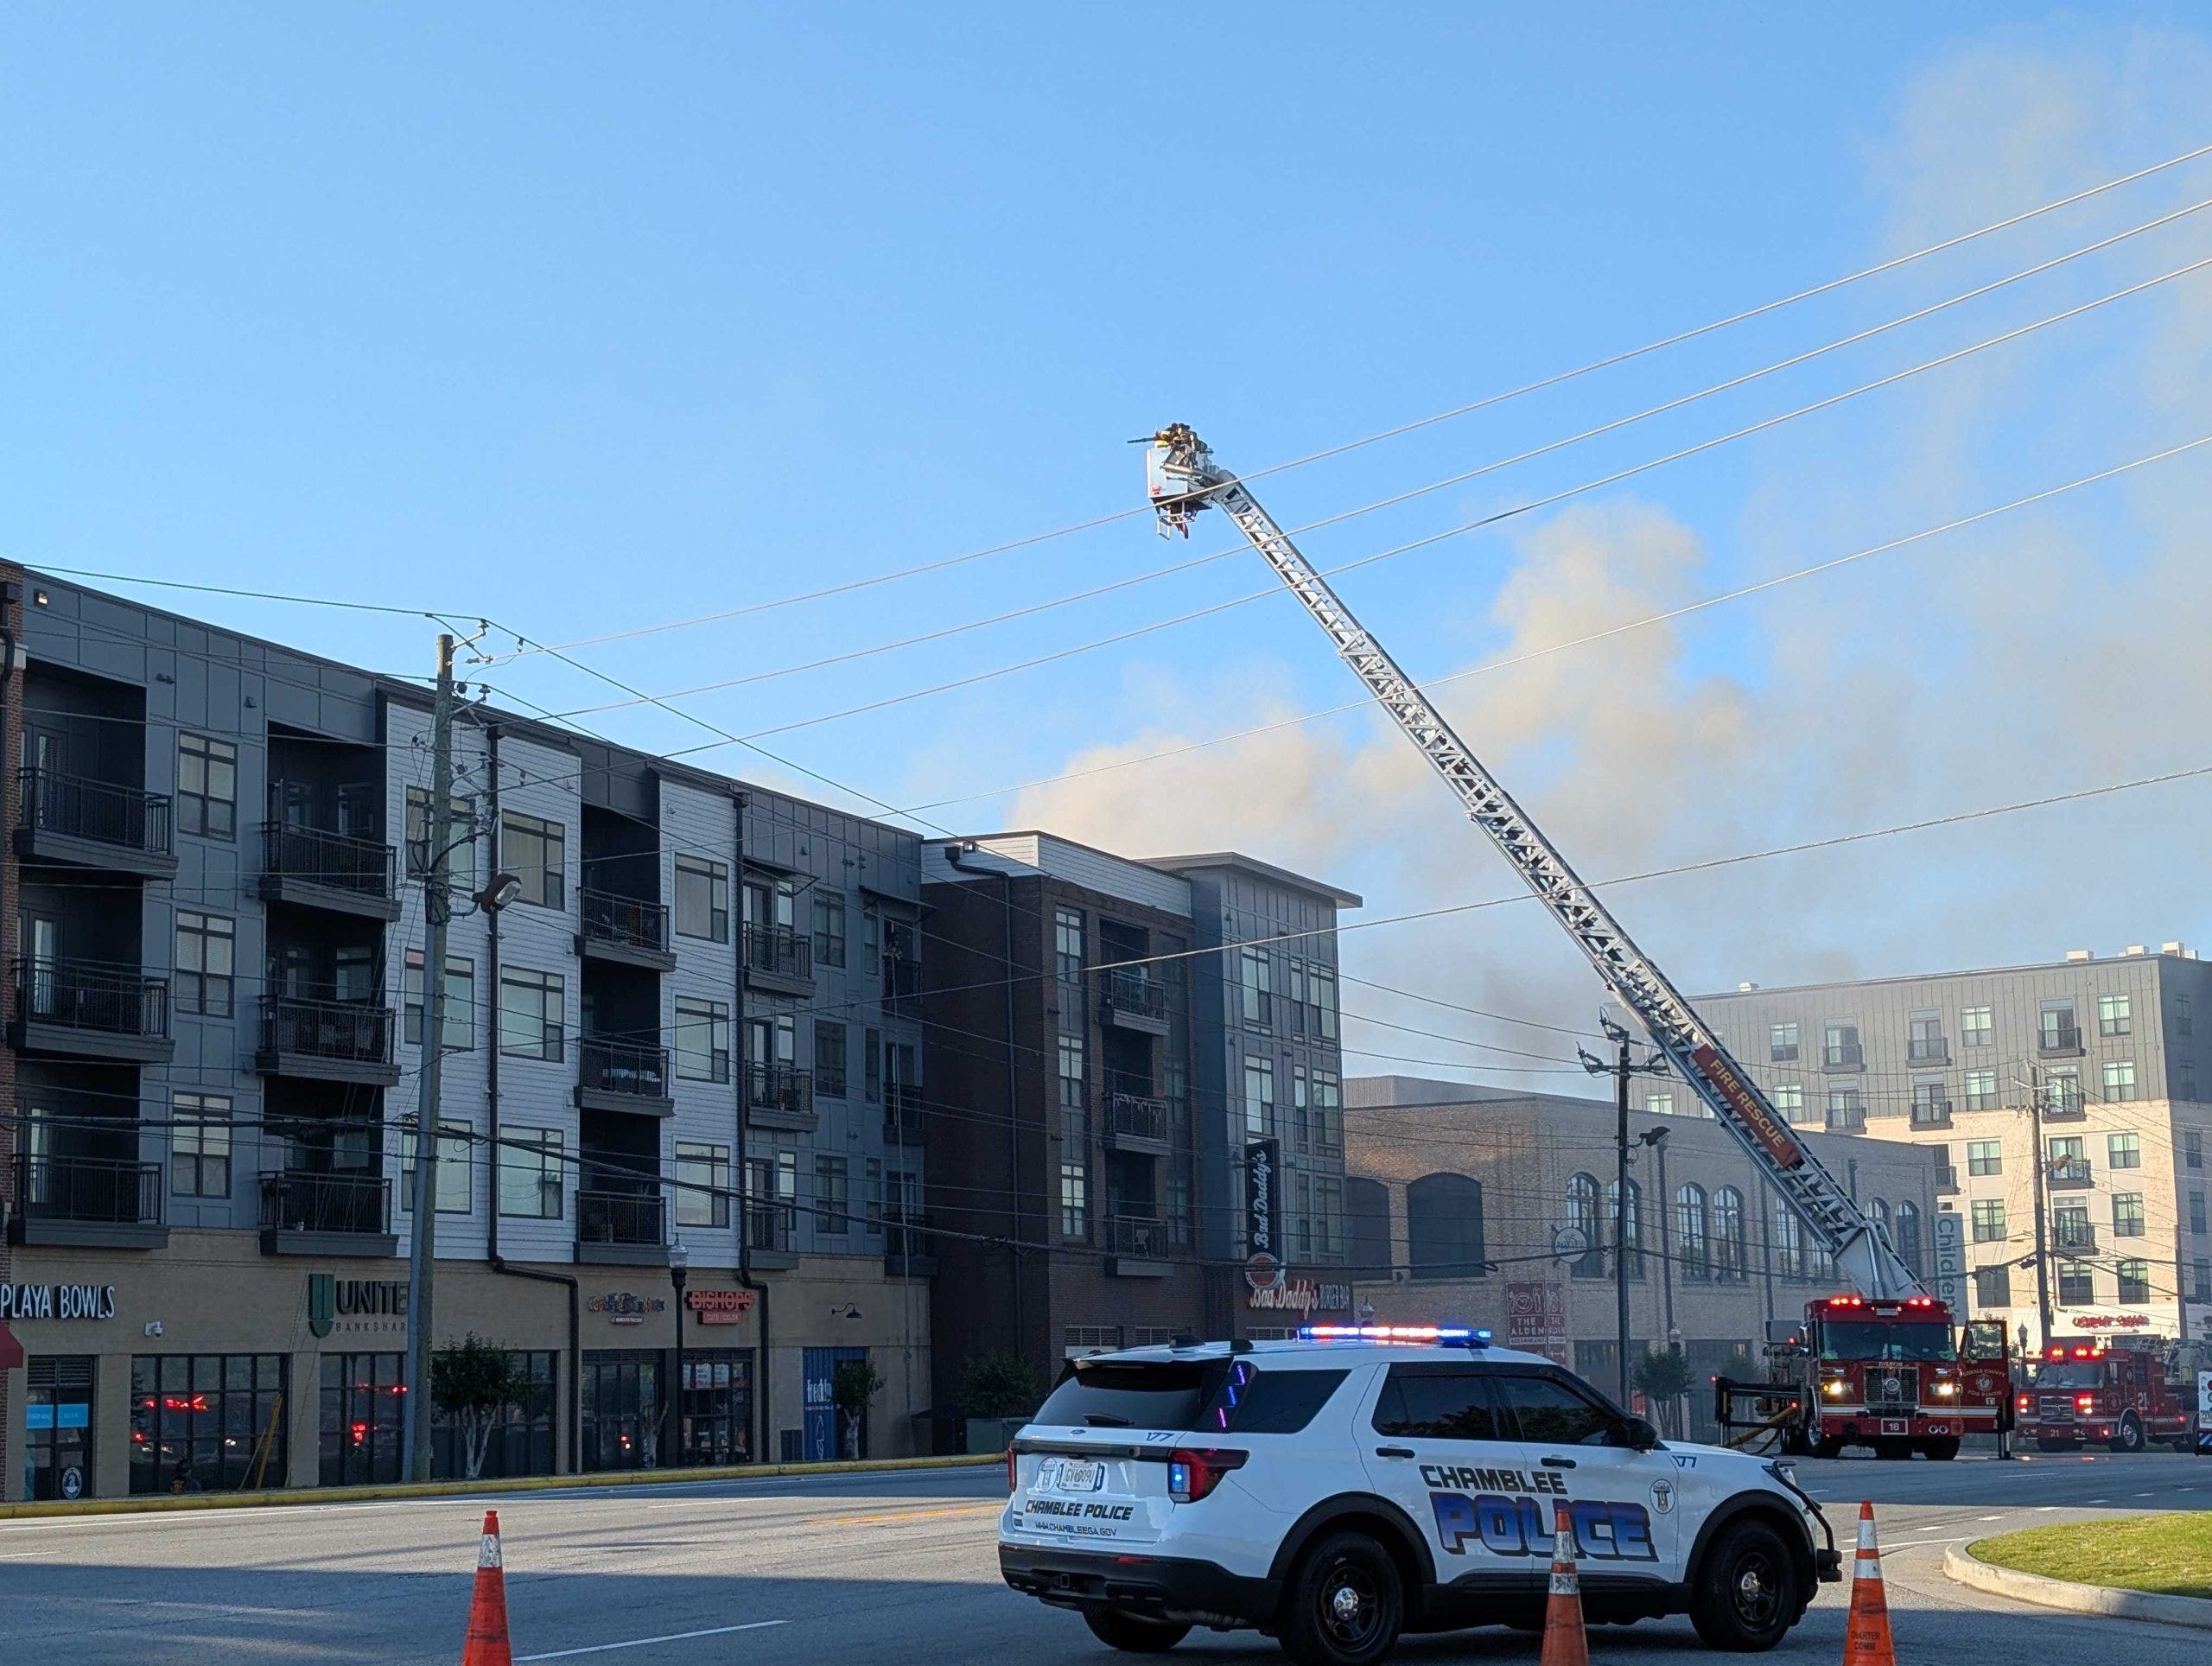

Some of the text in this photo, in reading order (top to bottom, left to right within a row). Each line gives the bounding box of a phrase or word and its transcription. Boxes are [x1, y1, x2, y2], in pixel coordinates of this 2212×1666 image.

[1709, 1059, 1786, 1148] FIRE RESCUE
[1253, 1149, 1272, 1214] Daddy's
[1254, 1214, 1269, 1249] Bad
[1937, 1218, 1957, 1323] Children'
[0, 1284, 116, 1319] PLAYA BOWLS
[336, 1281, 410, 1314] UNITE
[690, 1291, 754, 1310] BISHOPS
[1275, 1279, 1319, 1320] Daddy's
[335, 1322, 407, 1332] BANKSHAR
[1511, 1327, 1545, 1336] ALDEN
[1517, 1317, 1536, 1326] THE
[2138, 1392, 2148, 1410] 21
[1888, 1422, 1900, 1431] 18
[1419, 1465, 1568, 1495] CHAMBLEE
[1025, 1499, 1135, 1521] CHAMBLEE POLICE
